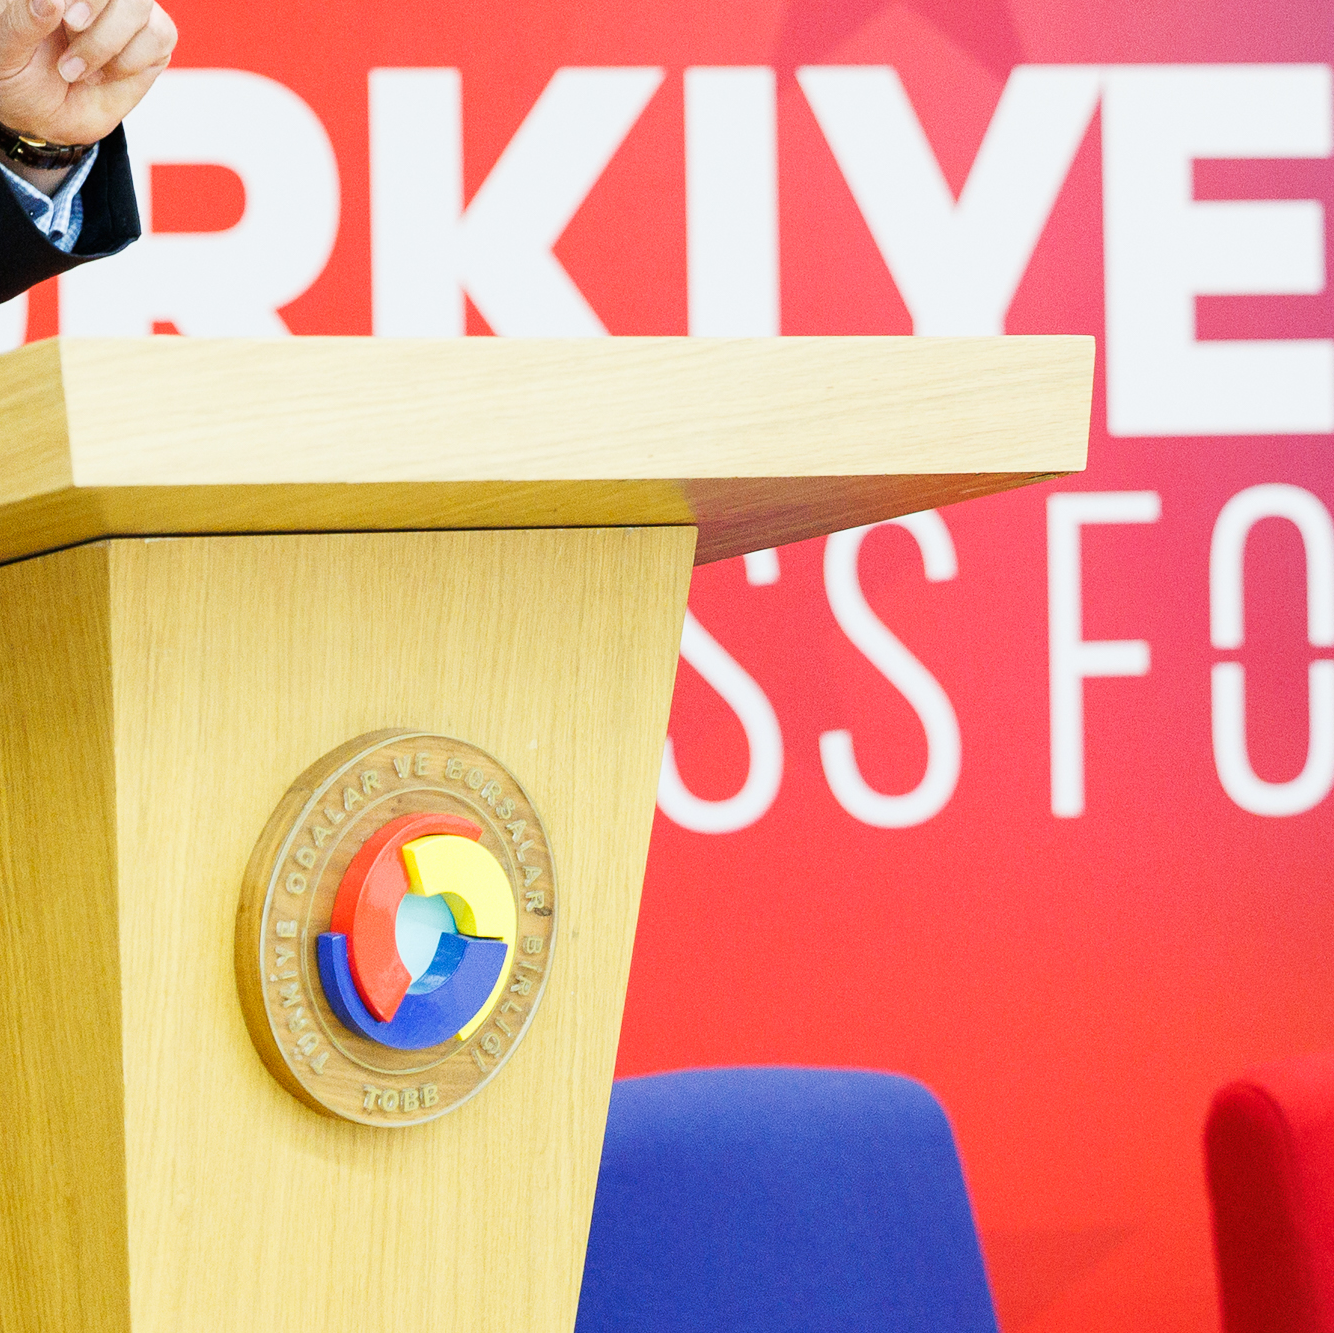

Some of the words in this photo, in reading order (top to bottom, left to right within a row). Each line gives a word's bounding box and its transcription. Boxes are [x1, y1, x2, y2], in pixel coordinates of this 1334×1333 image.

[285, 769, 382, 895] ODALAR
[393, 751, 431, 779] VE
[444, 757, 546, 913] BORSALAR
[363, 1082, 440, 1113] TOBB
